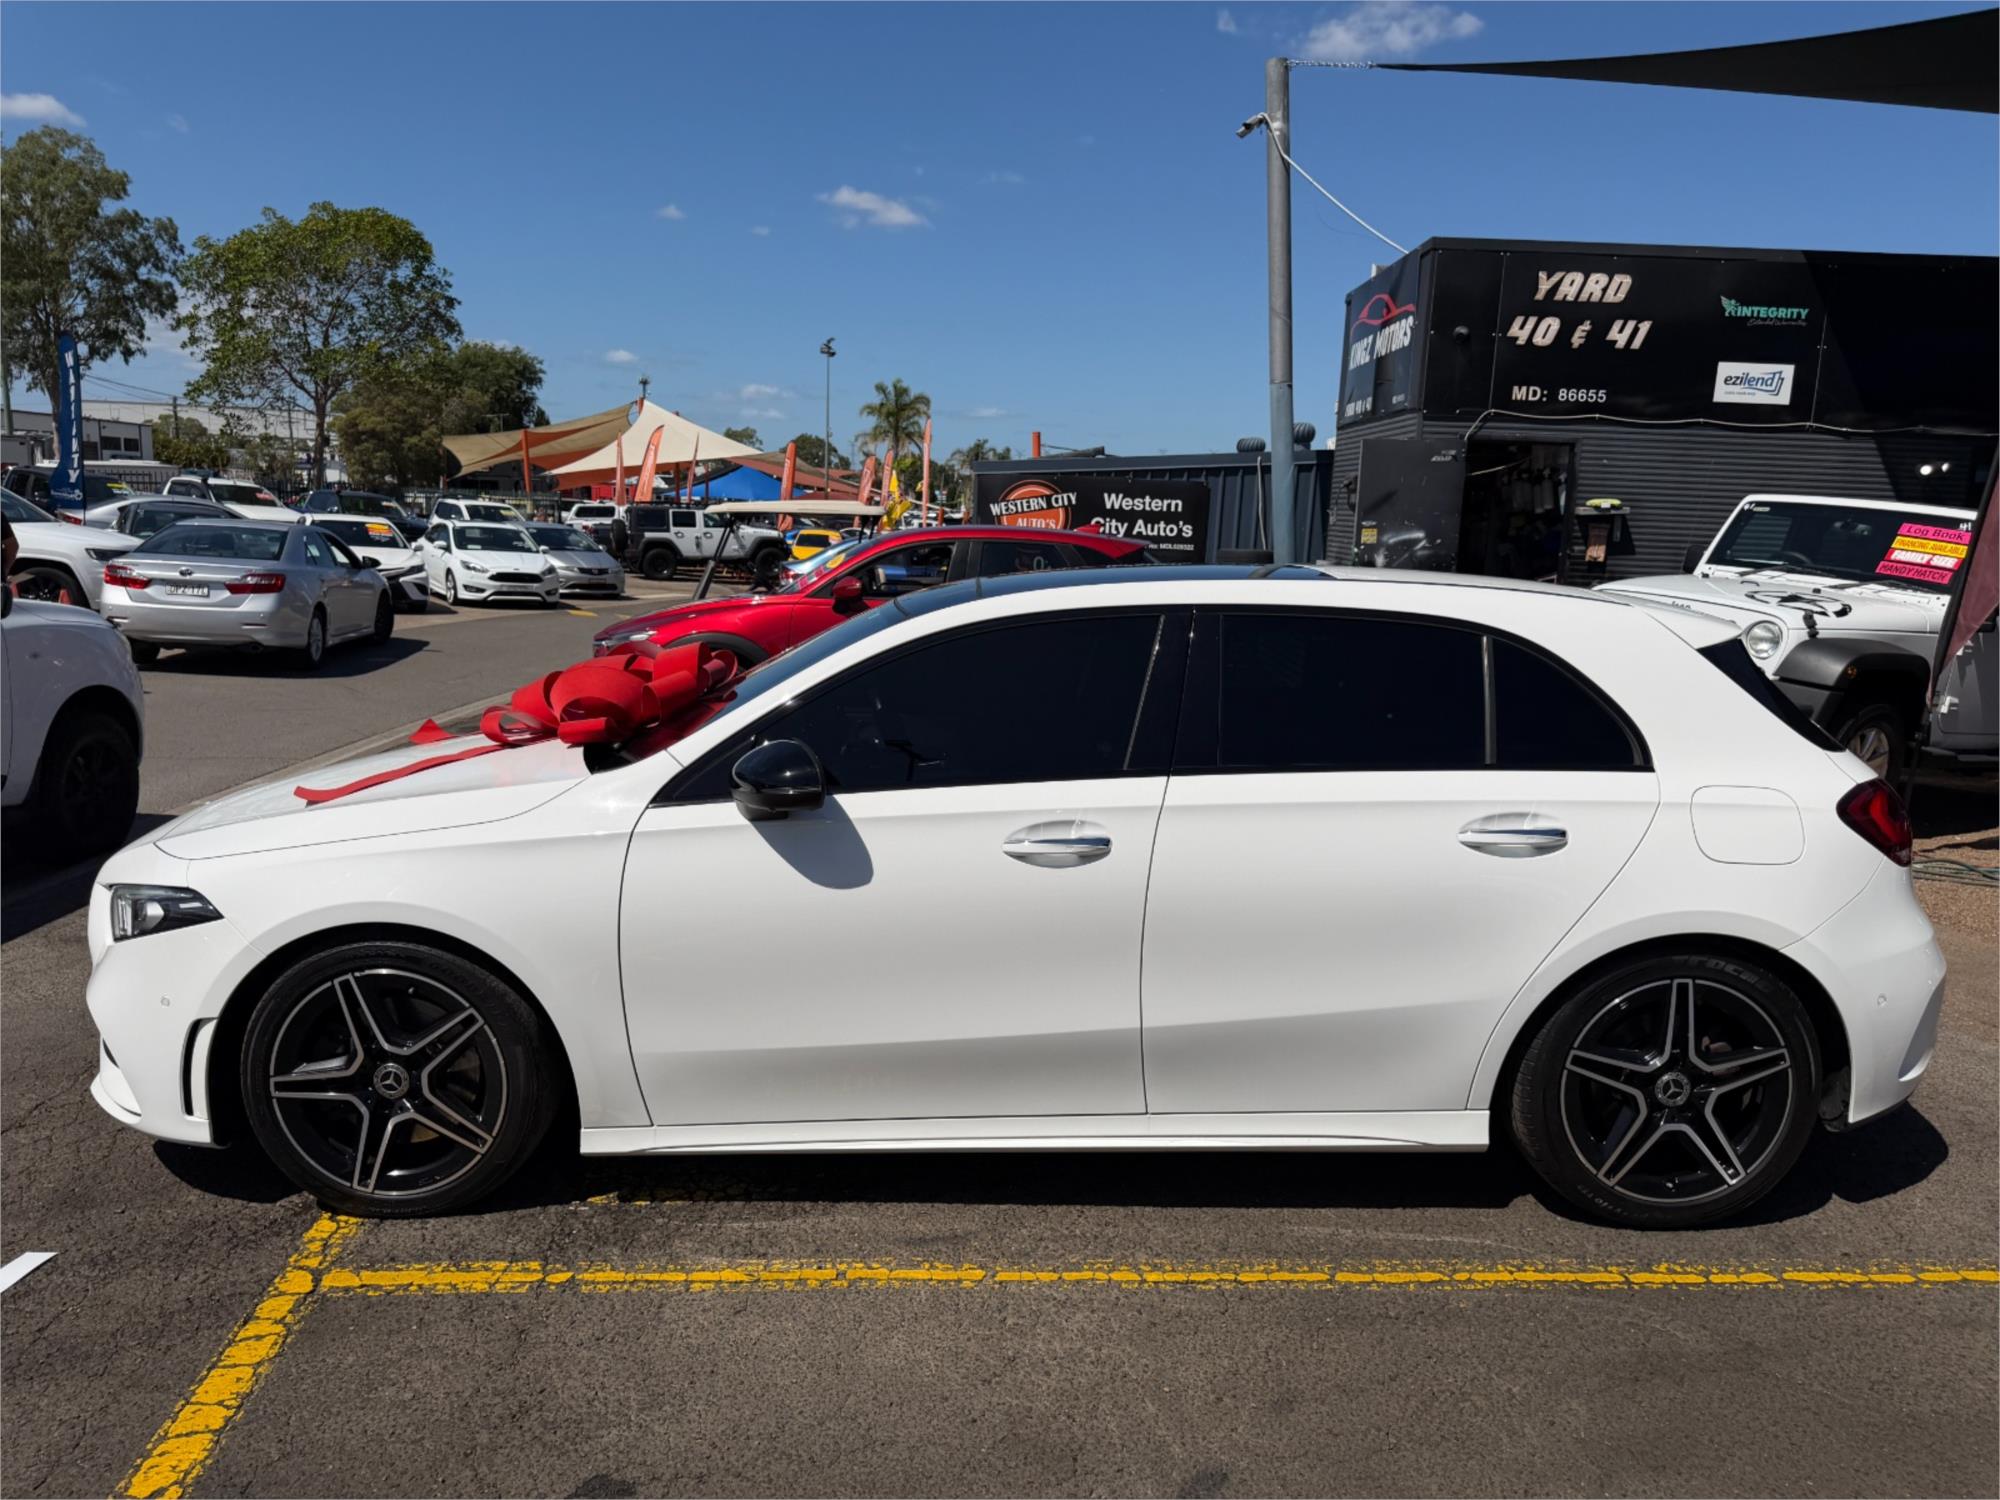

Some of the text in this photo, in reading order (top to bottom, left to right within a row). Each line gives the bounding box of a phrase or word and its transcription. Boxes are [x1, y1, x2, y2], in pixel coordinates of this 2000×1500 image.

[1534, 271, 1633, 303] YARD
[1737, 305, 1809, 320] INTEGRITY
[1373, 315, 1414, 360] MOTORS
[1507, 316, 1561, 347] 40
[1605, 319, 1653, 350] 41
[1723, 372, 1778, 388] ezilend
[1511, 386, 1607, 403] MD: 86655
[990, 492, 1078, 516] WESTERN CITY
[1104, 493, 1183, 512] Western
[1091, 517, 1193, 538] City Auto's
[1932, 529, 1965, 541] Book
[1913, 567, 1948, 582] HATCH
